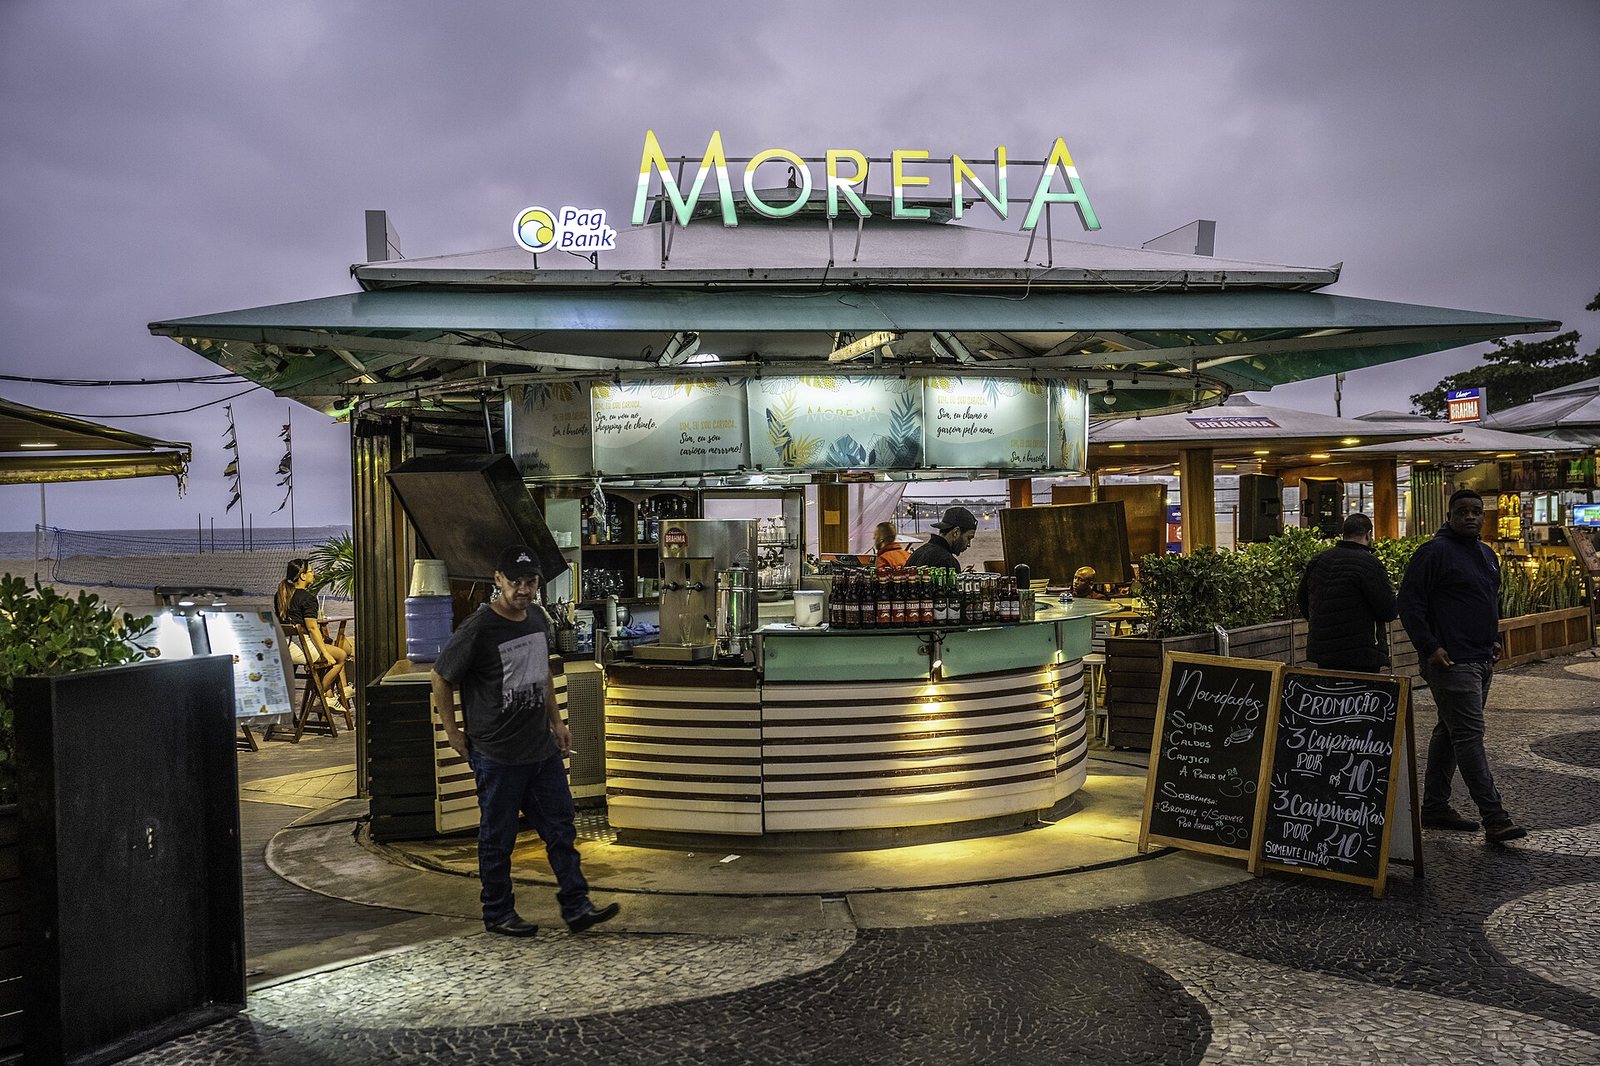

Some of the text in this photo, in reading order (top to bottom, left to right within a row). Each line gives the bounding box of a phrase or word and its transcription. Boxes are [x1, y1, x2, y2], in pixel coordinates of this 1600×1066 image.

[631, 129, 1101, 231] MORENA
[563, 210, 603, 231] Pag
[561, 229, 613, 247] Bank
[807, 405, 880, 422] MORENA
[1450, 401, 1479, 419] BRAHMA
[594, 420, 622, 434] shopping
[624, 421, 632, 430] de
[962, 423, 978, 438] pelo
[1195, 420, 1275, 428] BRAHMA
[680, 432, 696, 444] Sim,
[665, 535, 686, 543] BRAHMA
[1177, 669, 1264, 721] Novidades
[1298, 692, 1380, 716] PROMOÇÃO
[1286, 726, 1393, 756] 3 Caipirinhas
[1179, 765, 1188, 777] A
[1219, 777, 1256, 797] 30
[1296, 752, 1375, 792] POR R$ 40
[1217, 824, 1248, 844] 30
[1283, 821, 1362, 858] POR R$ 40
[1265, 840, 1330, 866] SOMENTE LIMÃO
